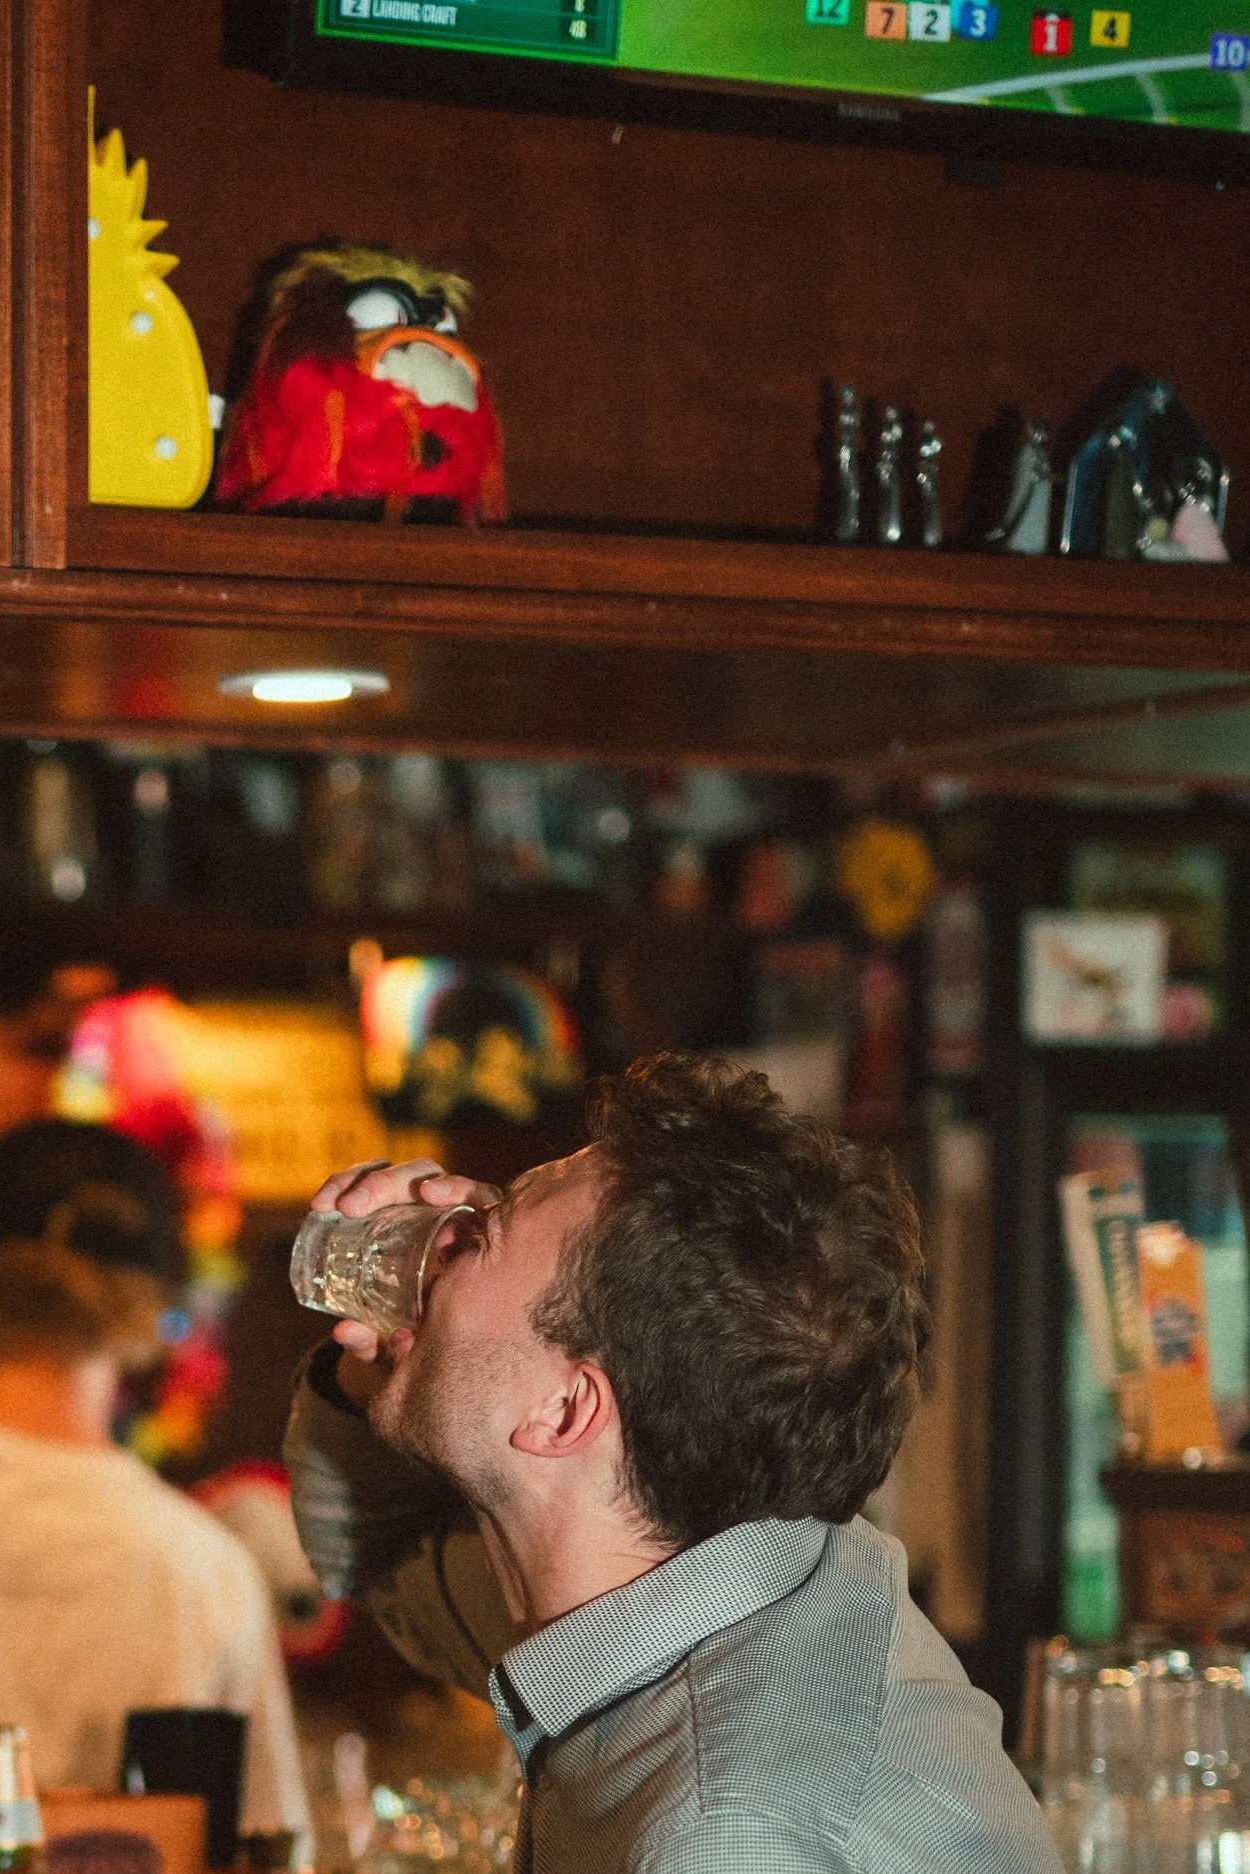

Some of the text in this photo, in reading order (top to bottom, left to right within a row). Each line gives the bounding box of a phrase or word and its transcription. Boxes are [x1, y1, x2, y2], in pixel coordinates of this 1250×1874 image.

[881, 7, 895, 34] 7
[924, 9, 939, 36] 2
[970, 8, 988, 36] 3
[1103, 17, 1118, 41] 4
[1043, 22, 1058, 52] 1
[1215, 39, 1245, 67] 10
